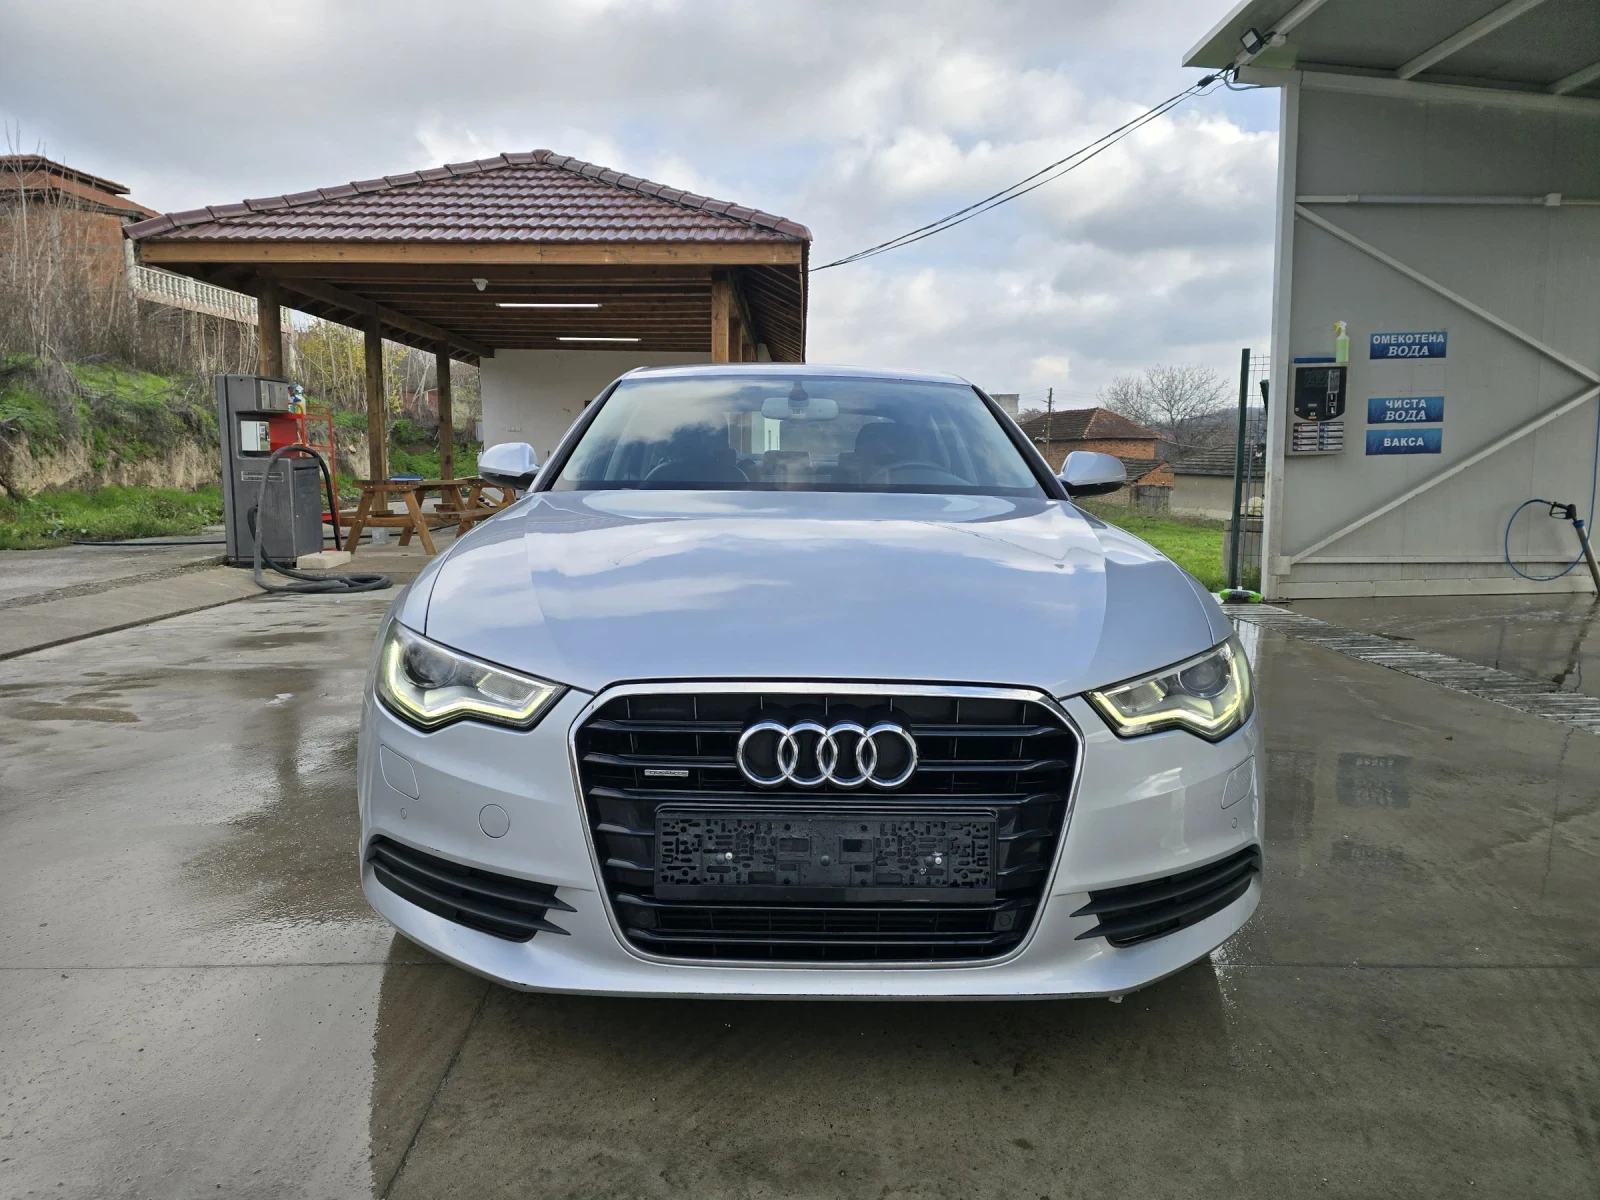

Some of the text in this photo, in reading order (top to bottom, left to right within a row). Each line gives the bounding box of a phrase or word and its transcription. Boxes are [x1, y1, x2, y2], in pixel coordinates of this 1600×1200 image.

[1372, 334, 1445, 344] ОМЕКОТЕНА
[1387, 345, 1430, 357] ВОДА
[1385, 399, 1427, 408] ЧИСТА
[1385, 410, 1427, 421] ВОДА
[1383, 437, 1425, 446] ВАКСА
